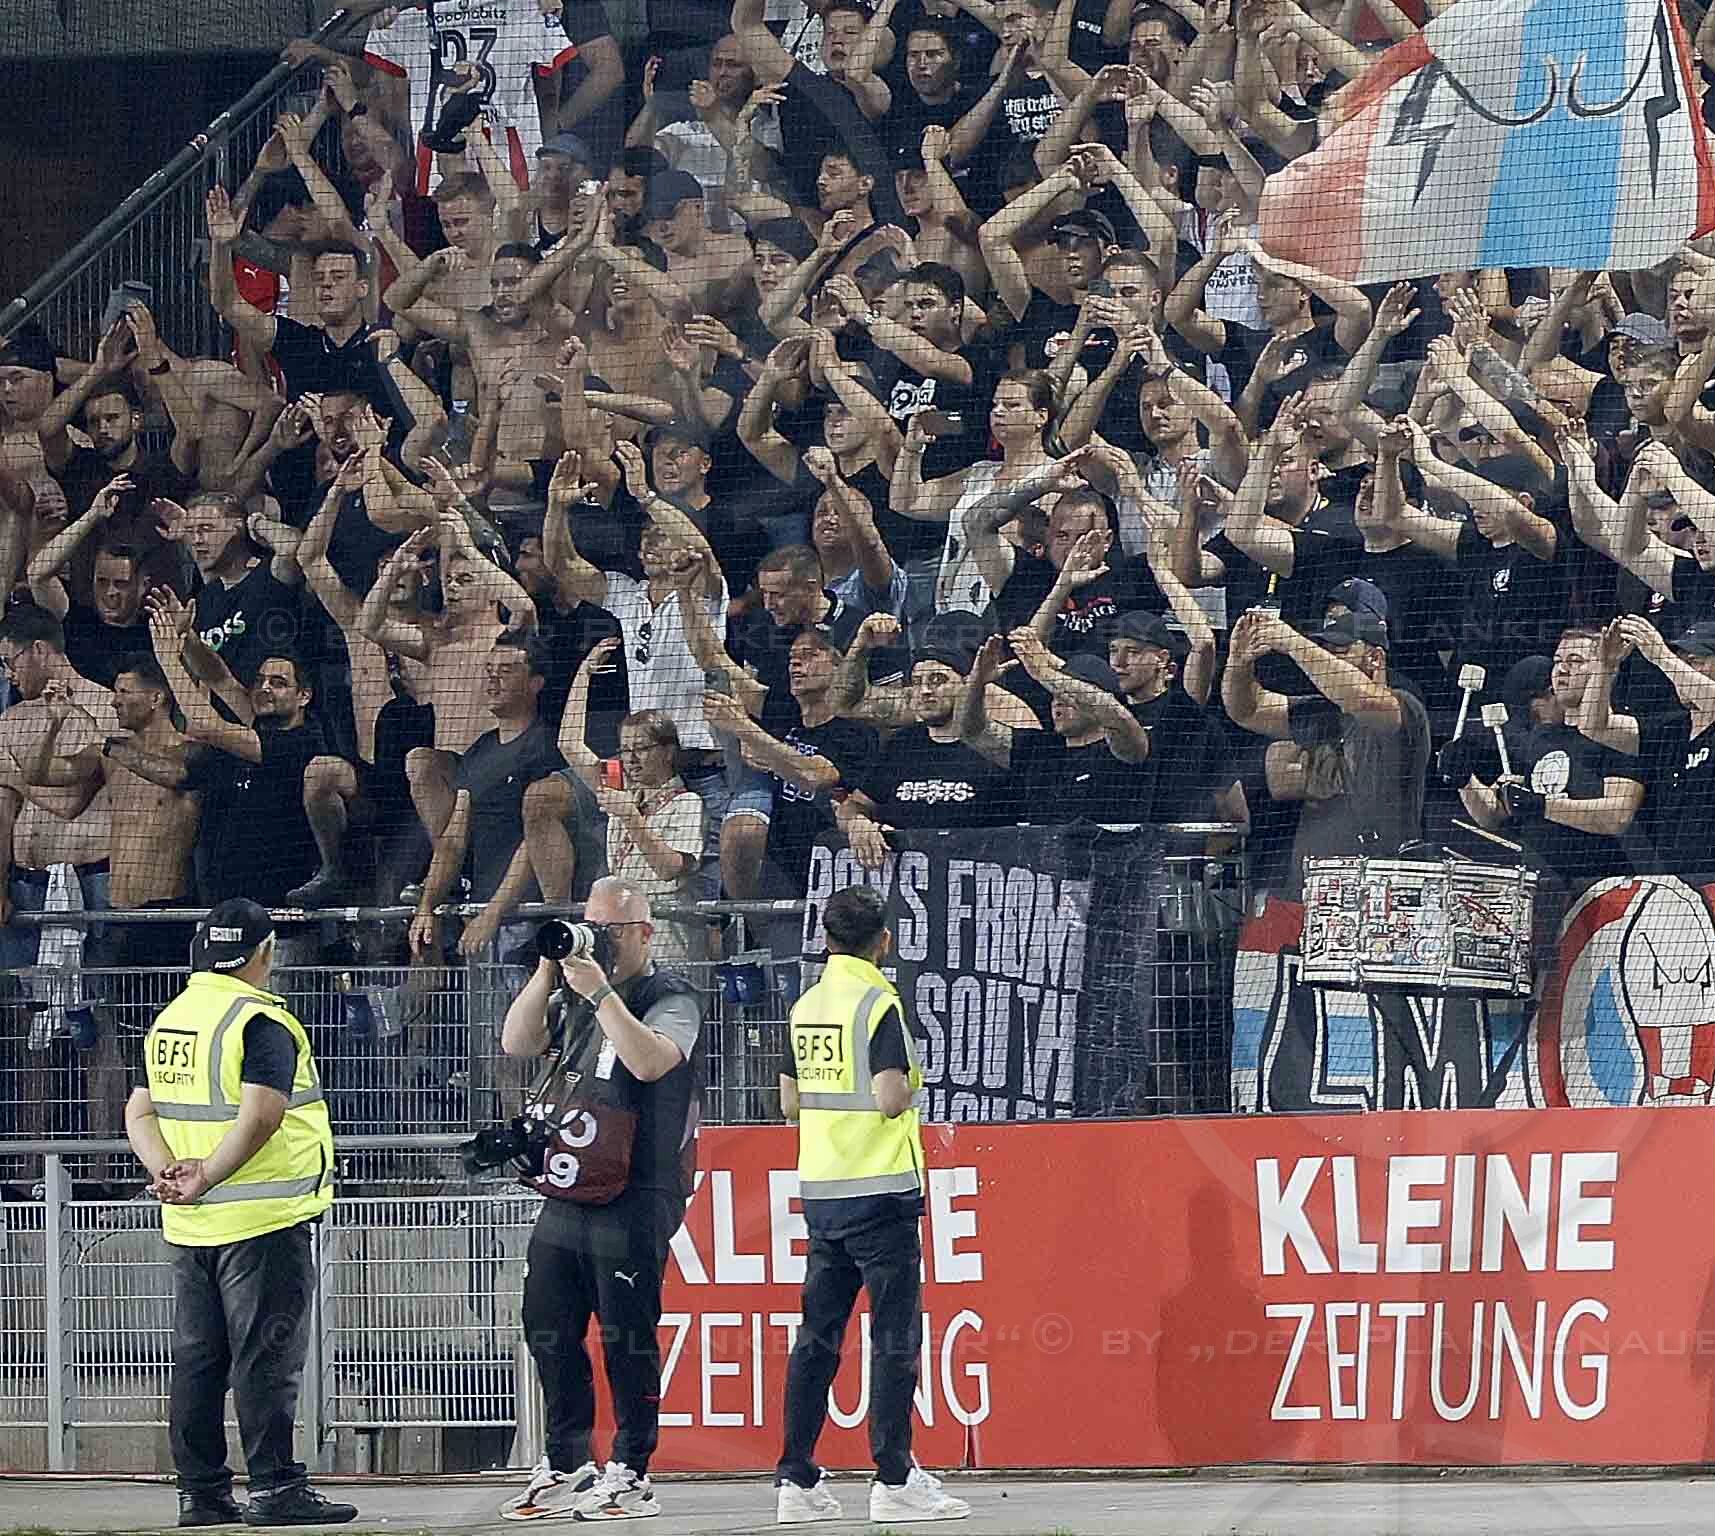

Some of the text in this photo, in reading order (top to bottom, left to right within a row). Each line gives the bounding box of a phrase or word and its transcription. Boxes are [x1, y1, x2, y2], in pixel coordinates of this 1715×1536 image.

[946, 859, 1094, 992] FROM
[154, 1070, 196, 1087] SECURITY
[157, 1038, 190, 1068] BFS
[797, 1034, 835, 1063] BFS
[914, 972, 1080, 1104] SOUTH
[668, 1165, 985, 1285] KLEE
[1255, 1150, 1619, 1276] KLEINE
[1268, 1297, 1610, 1421] ZEITUNG
